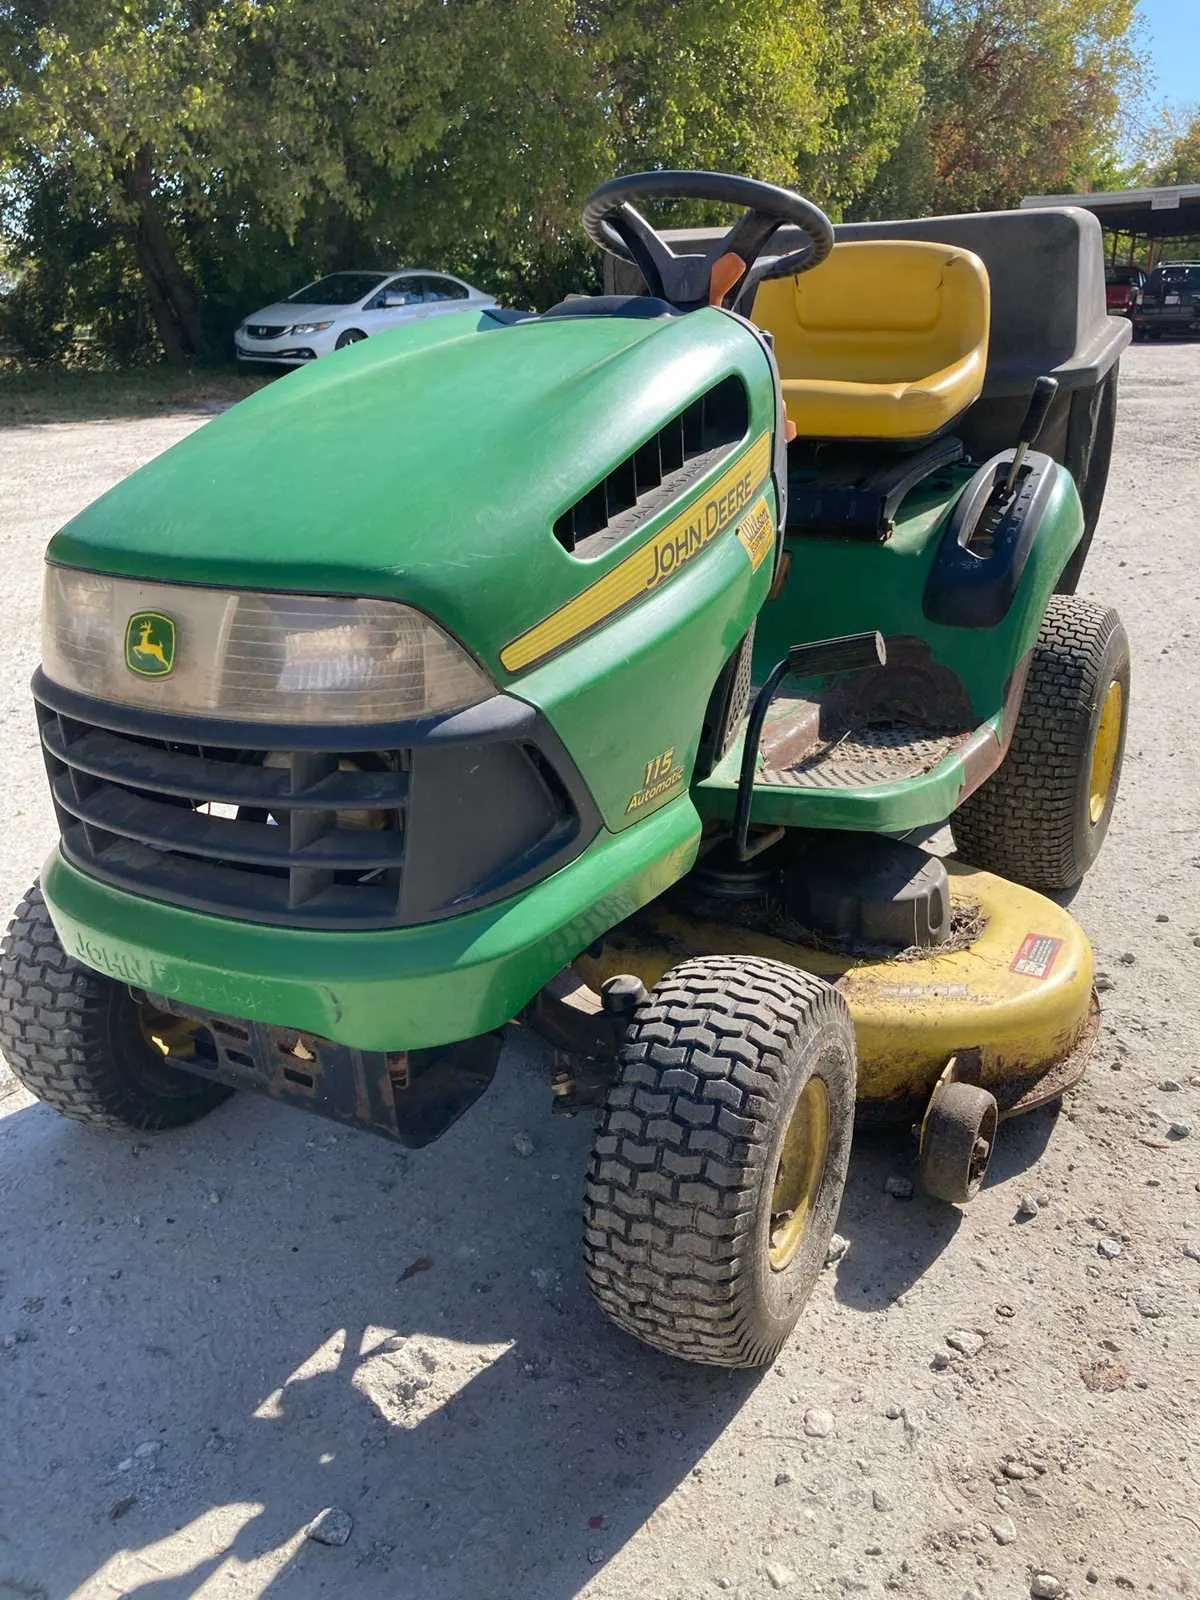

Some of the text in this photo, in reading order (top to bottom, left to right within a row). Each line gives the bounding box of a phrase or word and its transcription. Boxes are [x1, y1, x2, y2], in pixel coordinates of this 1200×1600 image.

[646, 518, 702, 586] JOHN
[704, 470, 752, 537] DEERE
[644, 746, 675, 786] 115
